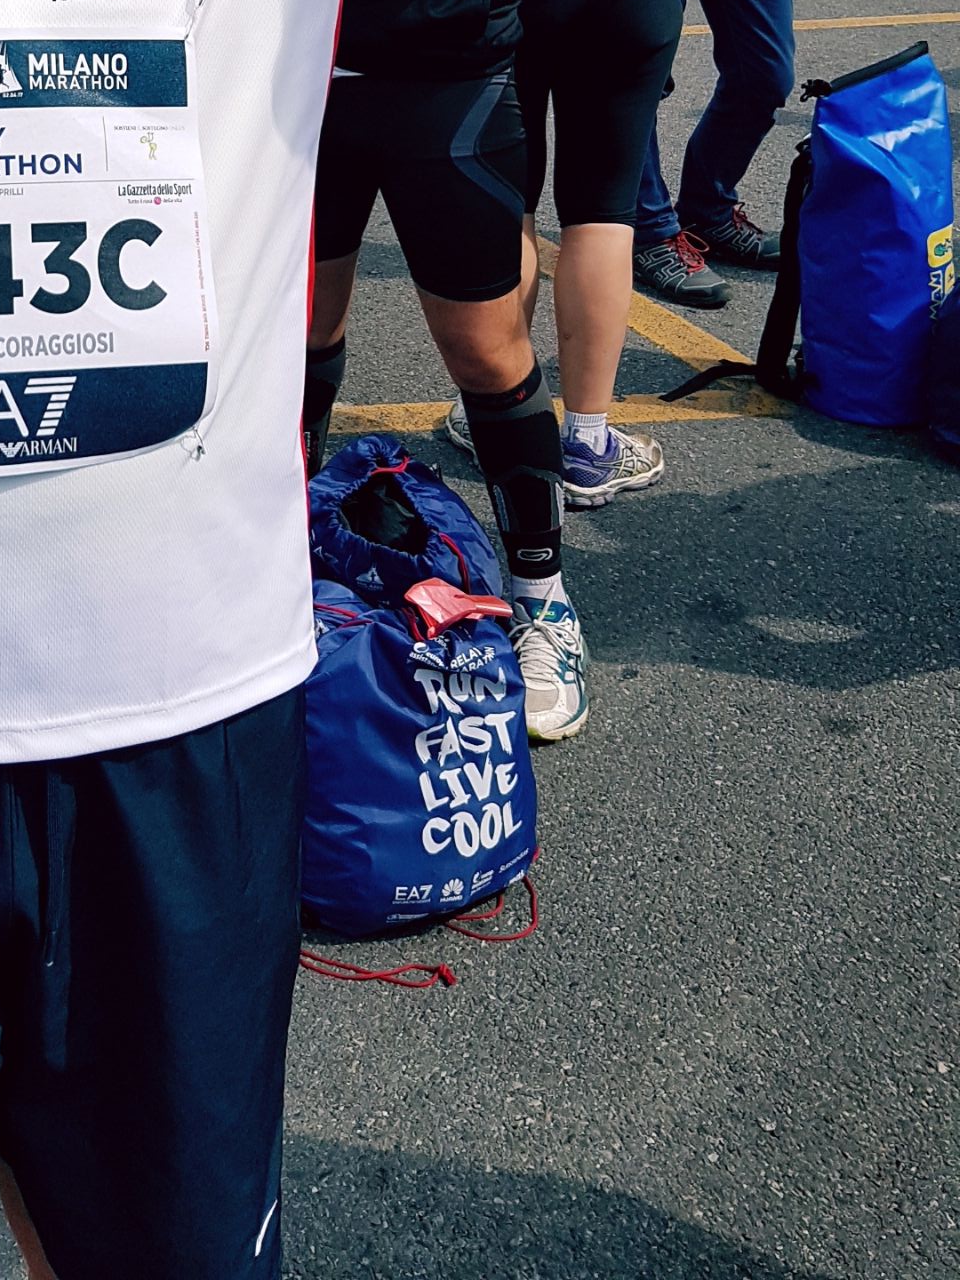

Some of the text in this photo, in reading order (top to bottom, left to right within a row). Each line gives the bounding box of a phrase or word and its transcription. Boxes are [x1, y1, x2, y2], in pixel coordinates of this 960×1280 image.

[27, 52, 128, 77] MILANO
[28, 74, 129, 91] MARATHON
[117, 183, 193, 197] La Gazzetta dello Sport
[19, 436, 78, 457] ARMANI
[413, 666, 507, 716] RUN
[414, 710, 517, 767] FAST
[418, 754, 519, 813] LIVE
[421, 800, 523, 858] COOL
[394, 884, 433, 901] EA7
